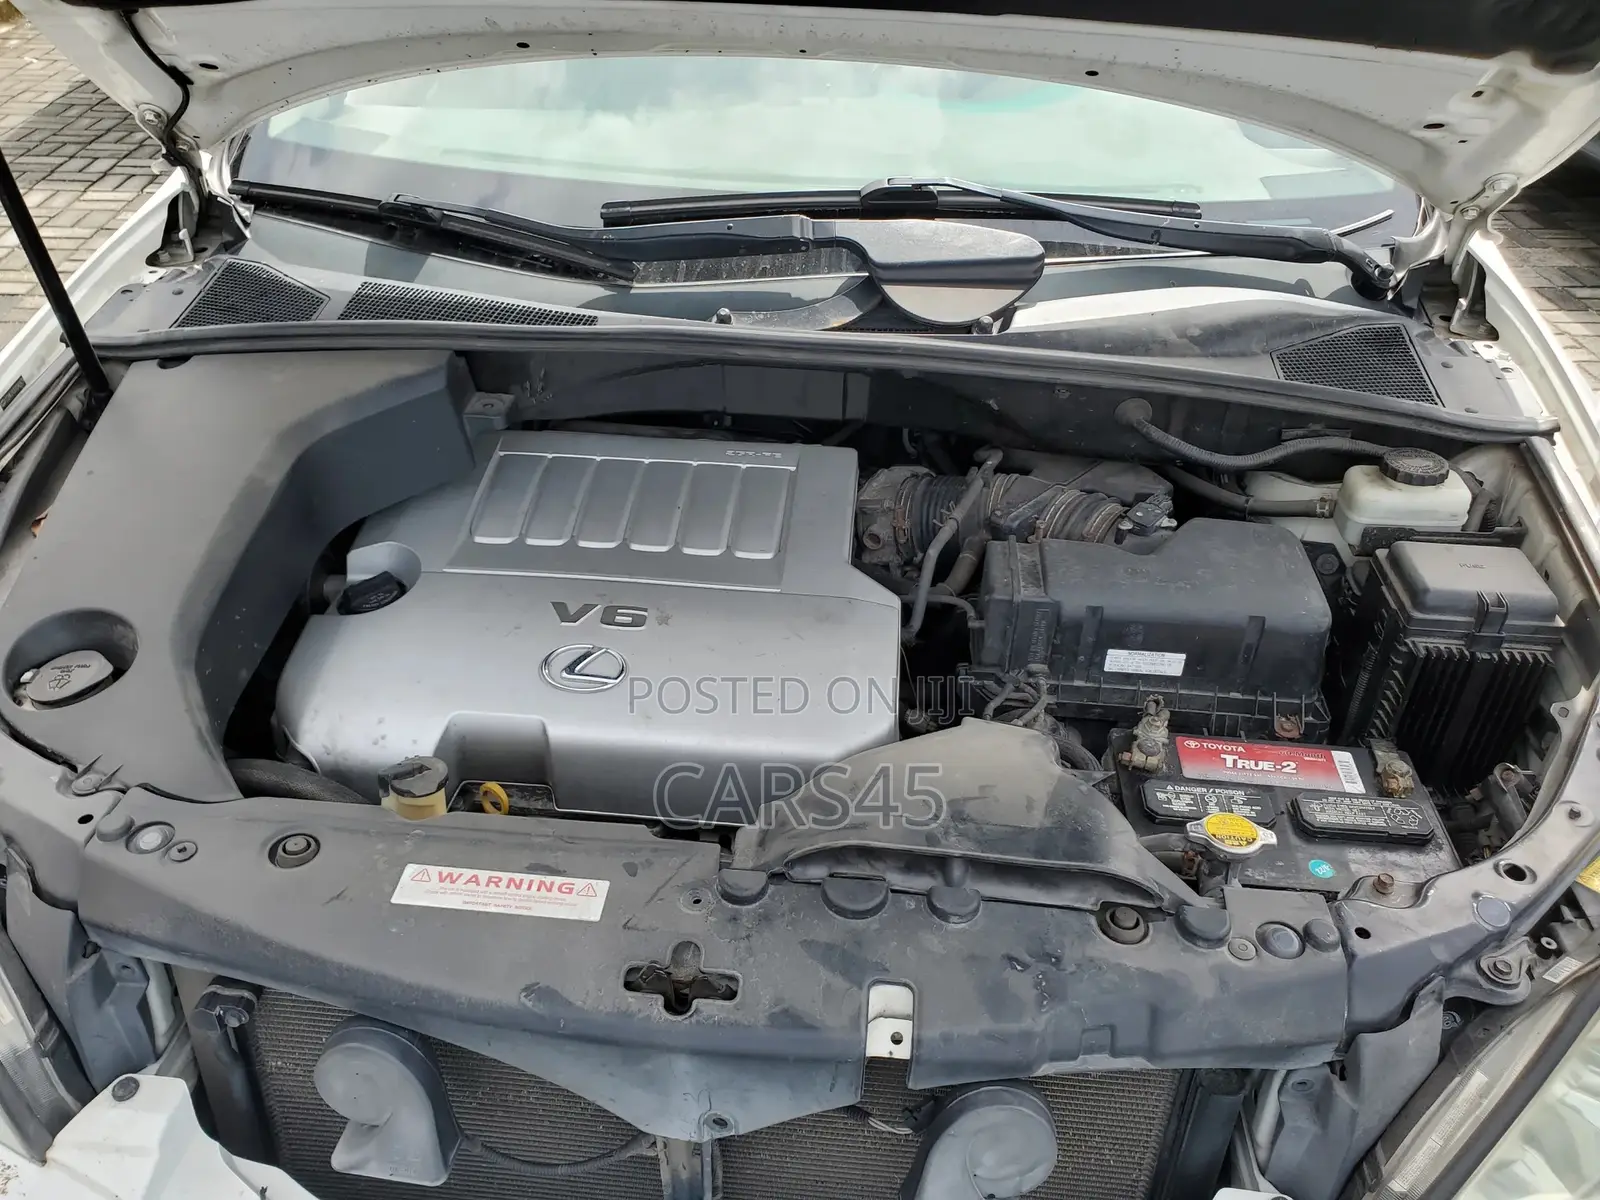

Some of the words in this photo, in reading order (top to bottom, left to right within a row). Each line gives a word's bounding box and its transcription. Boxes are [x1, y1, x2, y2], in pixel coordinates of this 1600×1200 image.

[550, 601, 649, 630] V6
[1202, 742, 1246, 753] TOYOTA
[1220, 753, 1298, 774] TRUE-2
[1174, 785, 1208, 793] DANGER
[1215, 788, 1246, 796] POISON
[437, 870, 576, 895] WARNING
